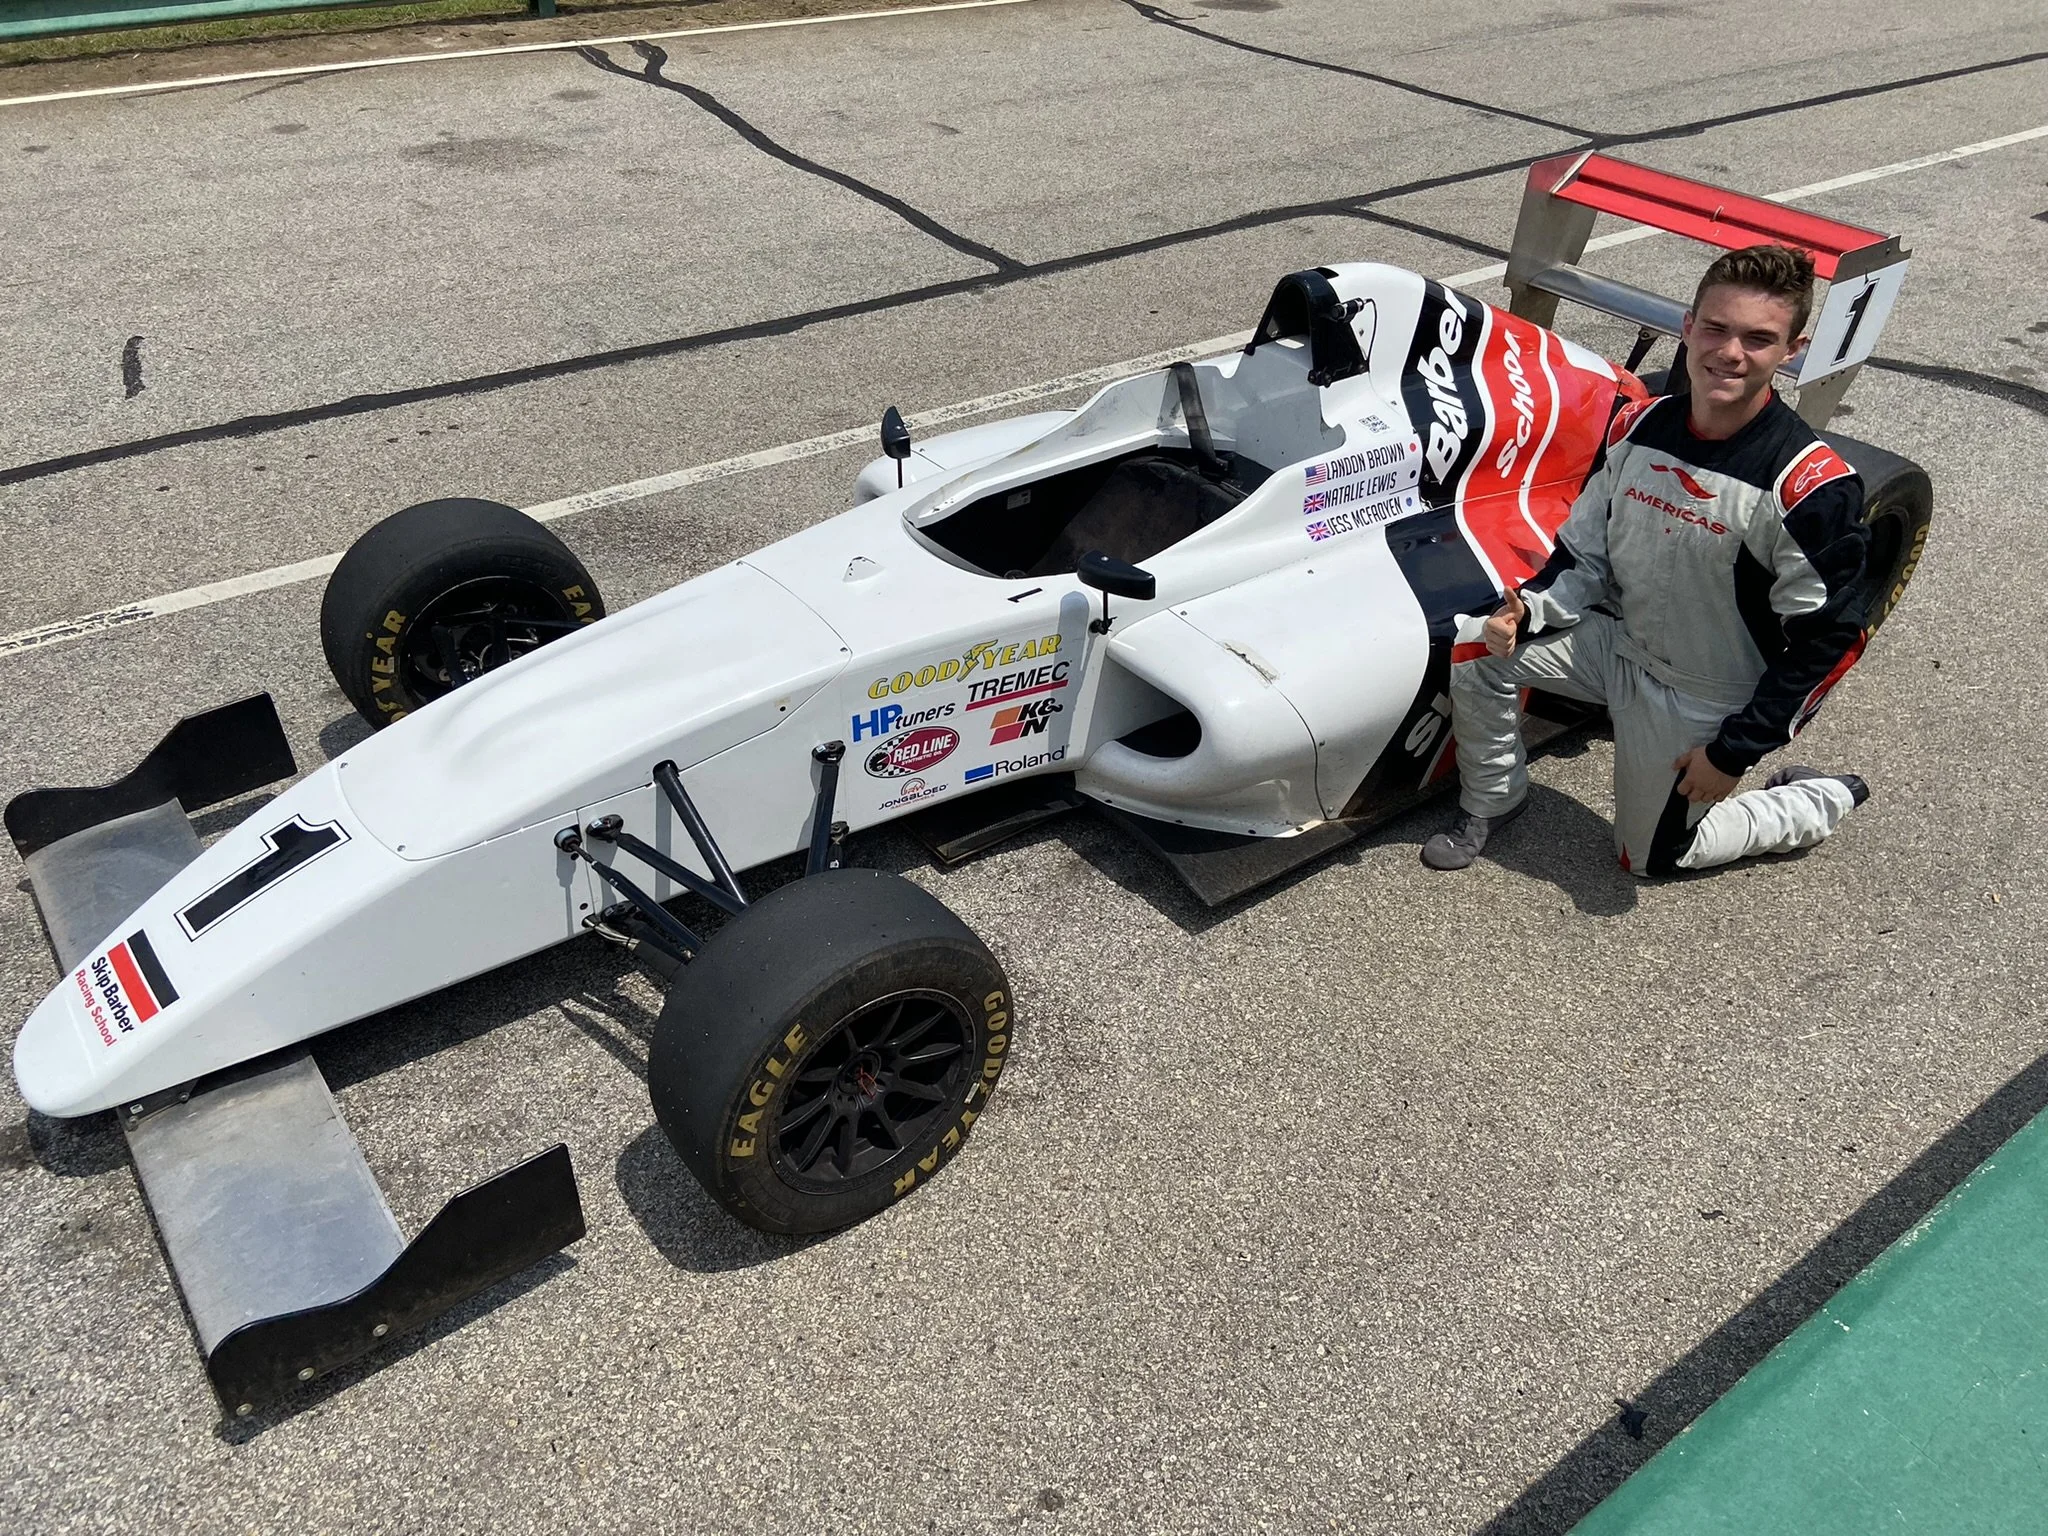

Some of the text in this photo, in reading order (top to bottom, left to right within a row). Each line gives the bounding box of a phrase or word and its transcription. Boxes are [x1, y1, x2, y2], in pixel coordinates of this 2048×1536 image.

[1830, 278, 1880, 366] 1
[1497, 328, 1535, 479] School
[1326, 442, 1405, 480] LANDON BROWN
[1324, 471, 1397, 508] NATALIE LEWIS
[1326, 514, 1353, 536] JESS
[1624, 487, 1730, 535] AMERICAS
[867, 633, 1062, 699] GOODYEAR
[968, 661, 1070, 702] TREMEC
[1017, 698, 1063, 722] K&
[1020, 716, 1049, 738] N
[893, 734, 953, 763] RED LINE
[995, 745, 1065, 777] Roland
[878, 784, 947, 810] JONGBLOED
[173, 813, 352, 943] 1
[75, 969, 117, 1047] Racing School
[91, 956, 135, 1033] Skip Barber
[730, 1023, 809, 1158] EAGLE
